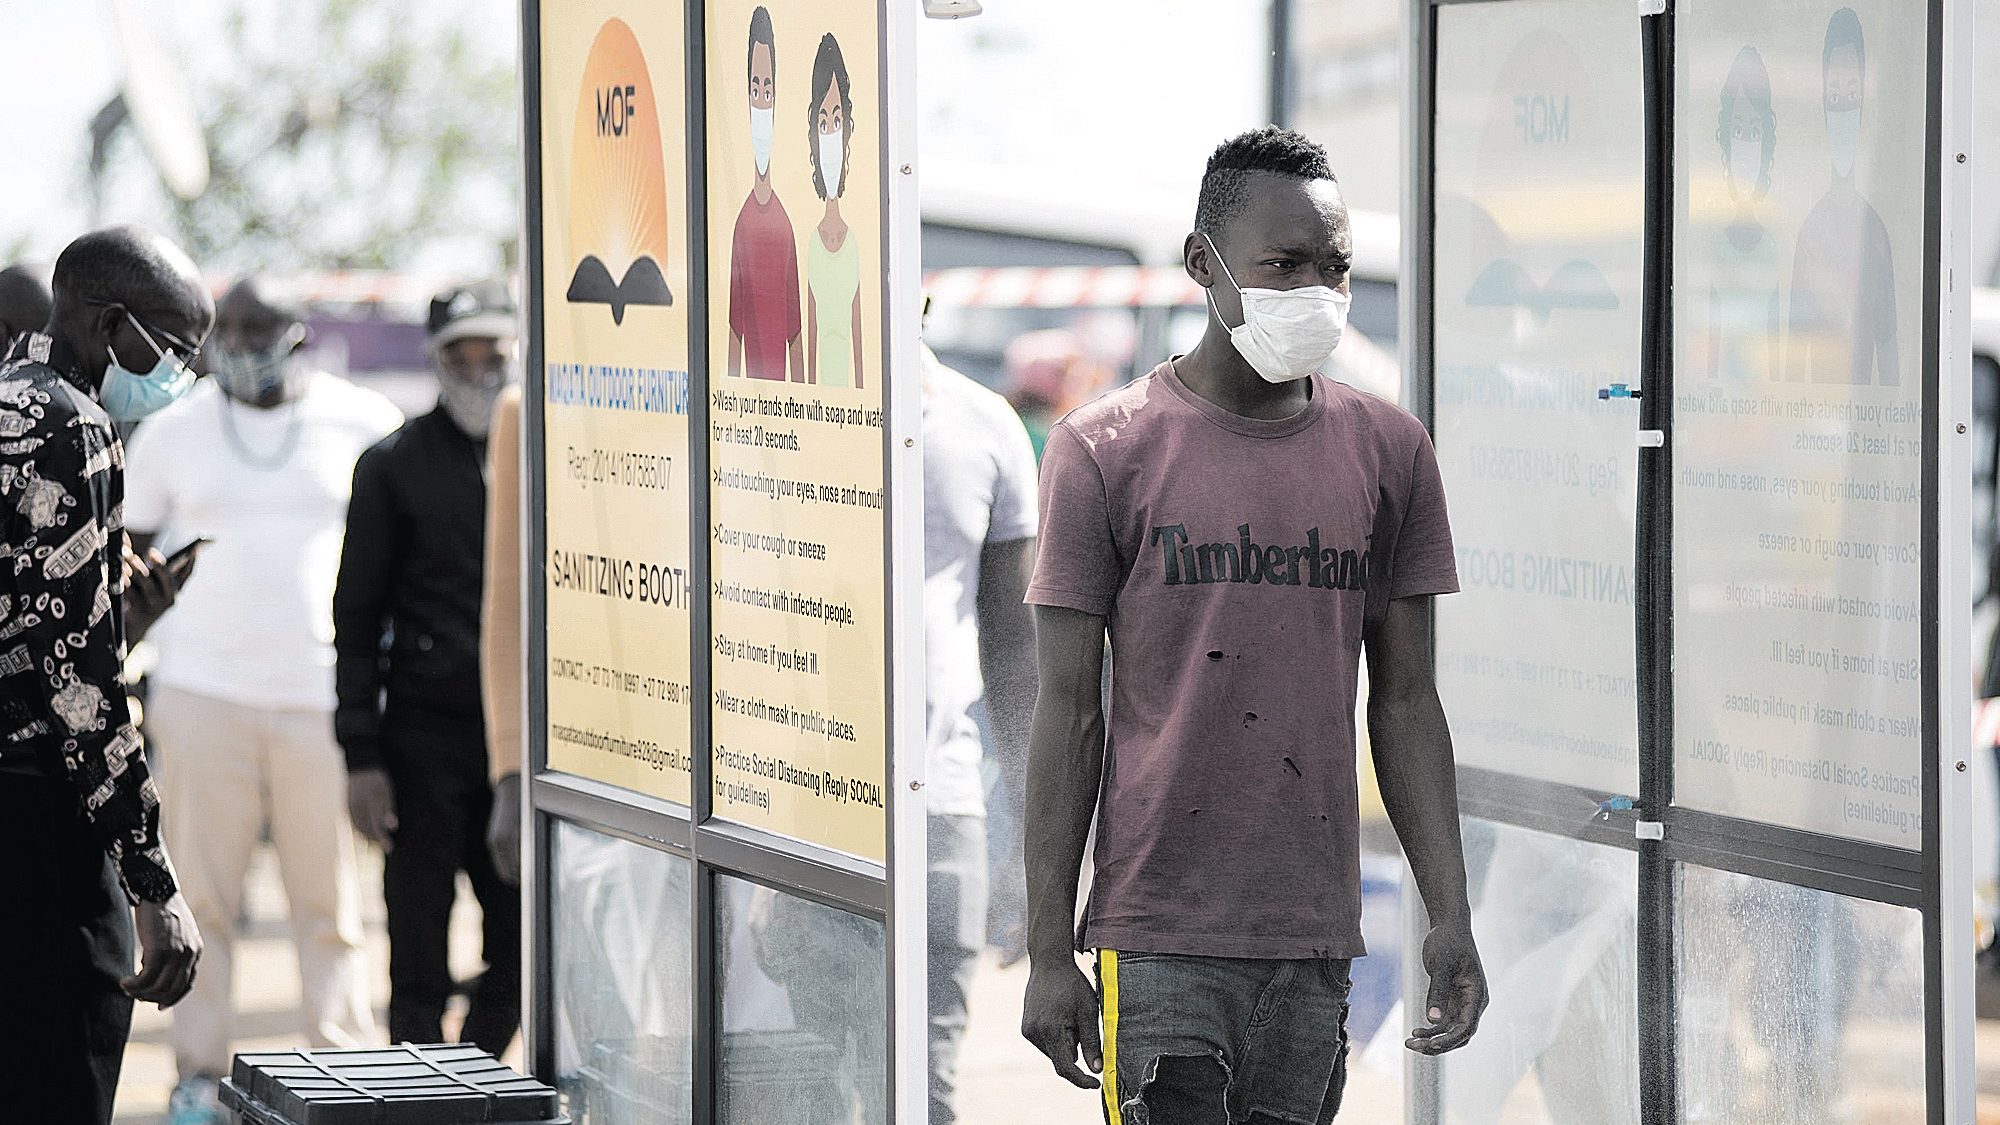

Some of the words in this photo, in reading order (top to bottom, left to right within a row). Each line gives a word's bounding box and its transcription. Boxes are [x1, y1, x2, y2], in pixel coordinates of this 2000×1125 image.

[597, 86, 635, 137] MOF
[588, 365, 635, 410] OUTDOOR
[739, 398, 756, 418] your
[759, 394, 782, 417] hands
[784, 397, 804, 419] often
[806, 399, 823, 422] with
[825, 405, 845, 429] soap
[847, 404, 863, 425] and
[713, 421, 723, 442] for
[725, 423, 733, 443] at
[734, 423, 753, 446] least
[754, 425, 763, 447] 20
[765, 429, 800, 452] seconds.
[741, 471, 775, 499] touching
[776, 478, 794, 500] your
[797, 482, 818, 504] eyes,
[819, 485, 839, 504] nose
[841, 484, 857, 506] and
[742, 532, 760, 553] your
[762, 532, 786, 559] cough
[788, 537, 796, 554] or
[798, 540, 826, 561] sneeze
[1151, 523, 1377, 590] Timberland
[553, 550, 633, 600] SANITIZING
[639, 563, 690, 610] BOOTH
[742, 586, 770, 609] contact
[772, 589, 789, 612] with
[790, 592, 823, 619] infected
[824, 601, 855, 628] people.
[738, 638, 745, 656] at
[746, 639, 768, 664] home
[770, 643, 776, 666] if
[777, 649, 792, 672] you
[794, 649, 808, 673] feel
[810, 652, 820, 675] ill.
[657, 679, 666, 700] 72
[667, 681, 679, 703] 980
[681, 685, 691, 706] 17
[747, 697, 767, 720] cloth
[768, 704, 790, 726] mask
[791, 706, 799, 728] in
[801, 710, 826, 735] public
[827, 715, 857, 742] places.
[716, 775, 726, 798] for
[728, 780, 770, 815] guidelines)
[752, 753, 776, 779] Social
[778, 759, 820, 797] Distancing
[822, 770, 848, 804] (Reply
[850, 779, 883, 809] SOCIAL
